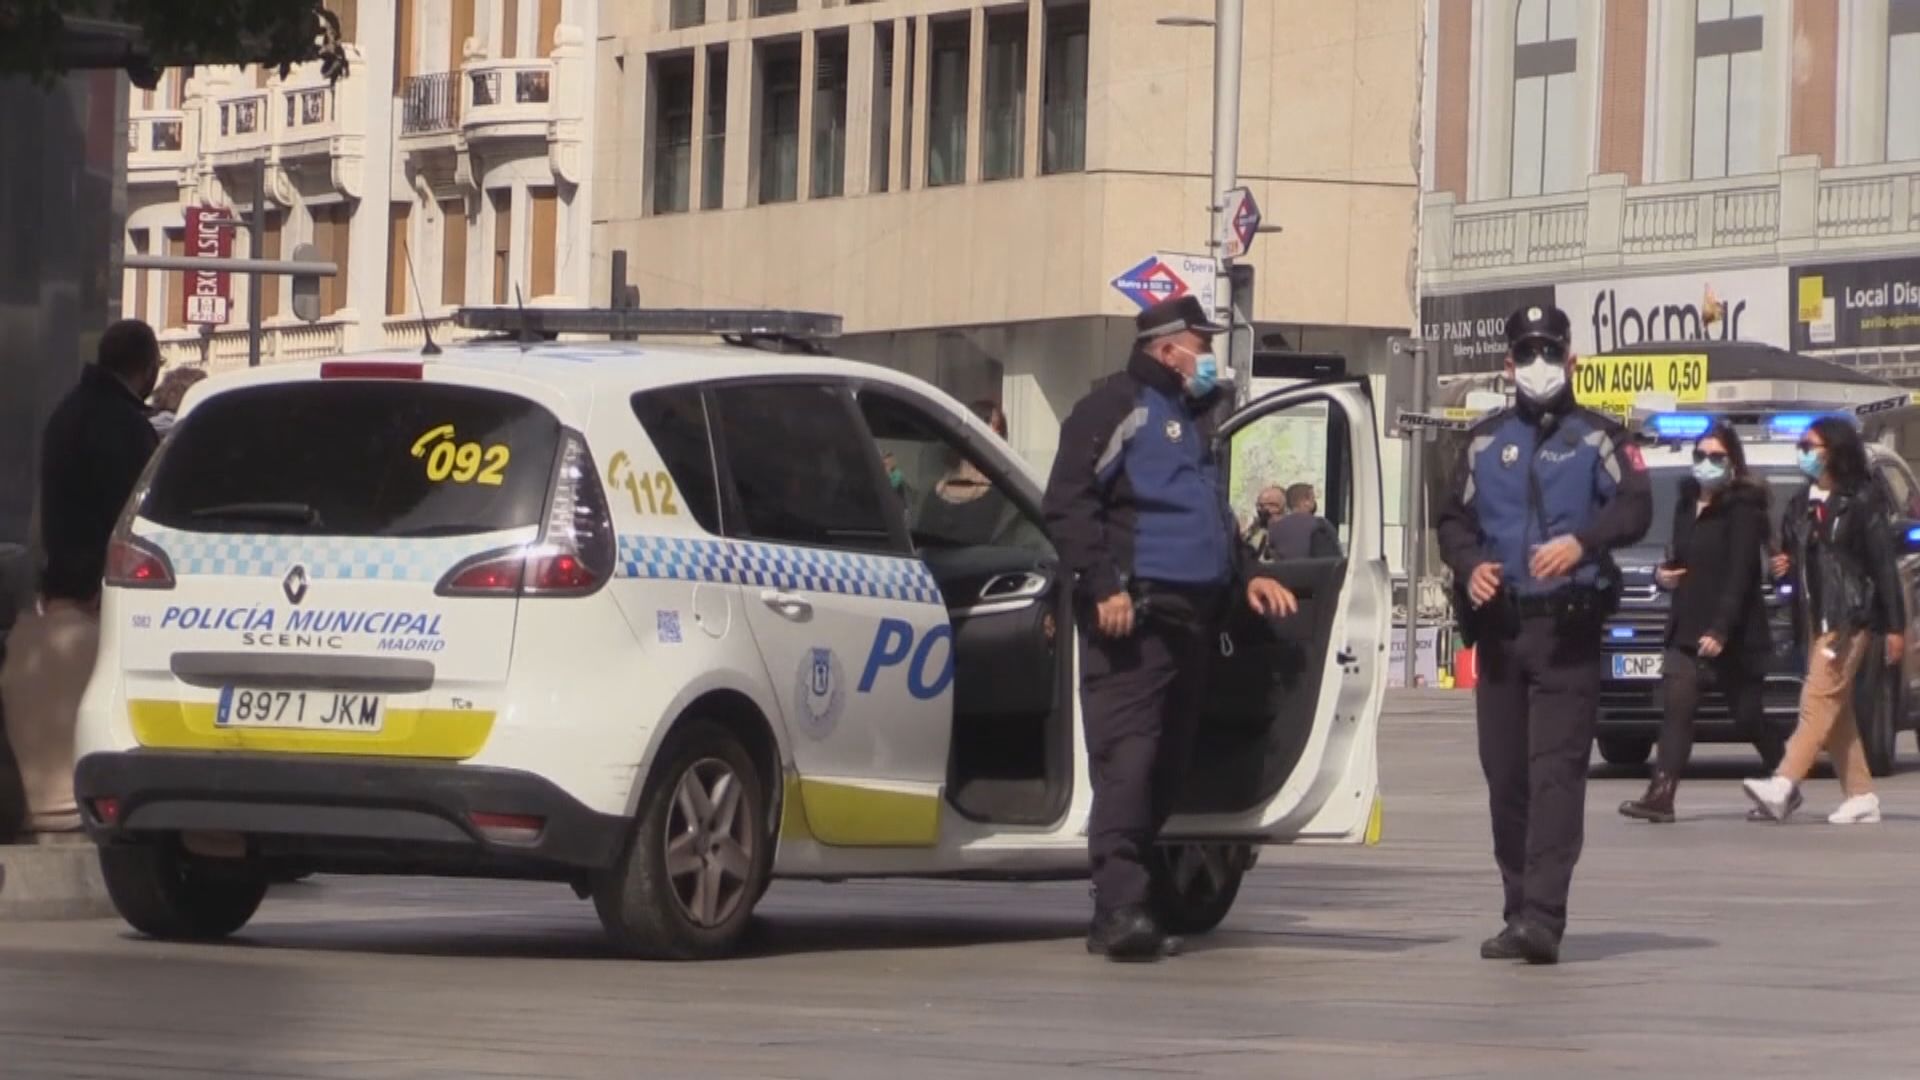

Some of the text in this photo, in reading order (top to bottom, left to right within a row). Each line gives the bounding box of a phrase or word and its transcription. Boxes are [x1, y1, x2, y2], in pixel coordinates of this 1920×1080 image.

[1845, 282, 1888, 309] Local
[1424, 324, 1440, 341] LE
[1443, 320, 1472, 339] PAIN
[1592, 289, 1746, 354] flormar
[1610, 362, 1654, 392] AGUA
[1668, 361, 1701, 397] 0,50
[426, 441, 510, 486] 092
[625, 470, 678, 515] 112
[160, 602, 275, 631] POLICÍA
[285, 610, 442, 636] MUNICIPAL
[242, 632, 343, 649] SCENIC
[377, 637, 446, 652] MADRID
[857, 618, 956, 700] PO
[1623, 657, 1655, 675] CNP
[235, 691, 379, 726] 8971 JKM
